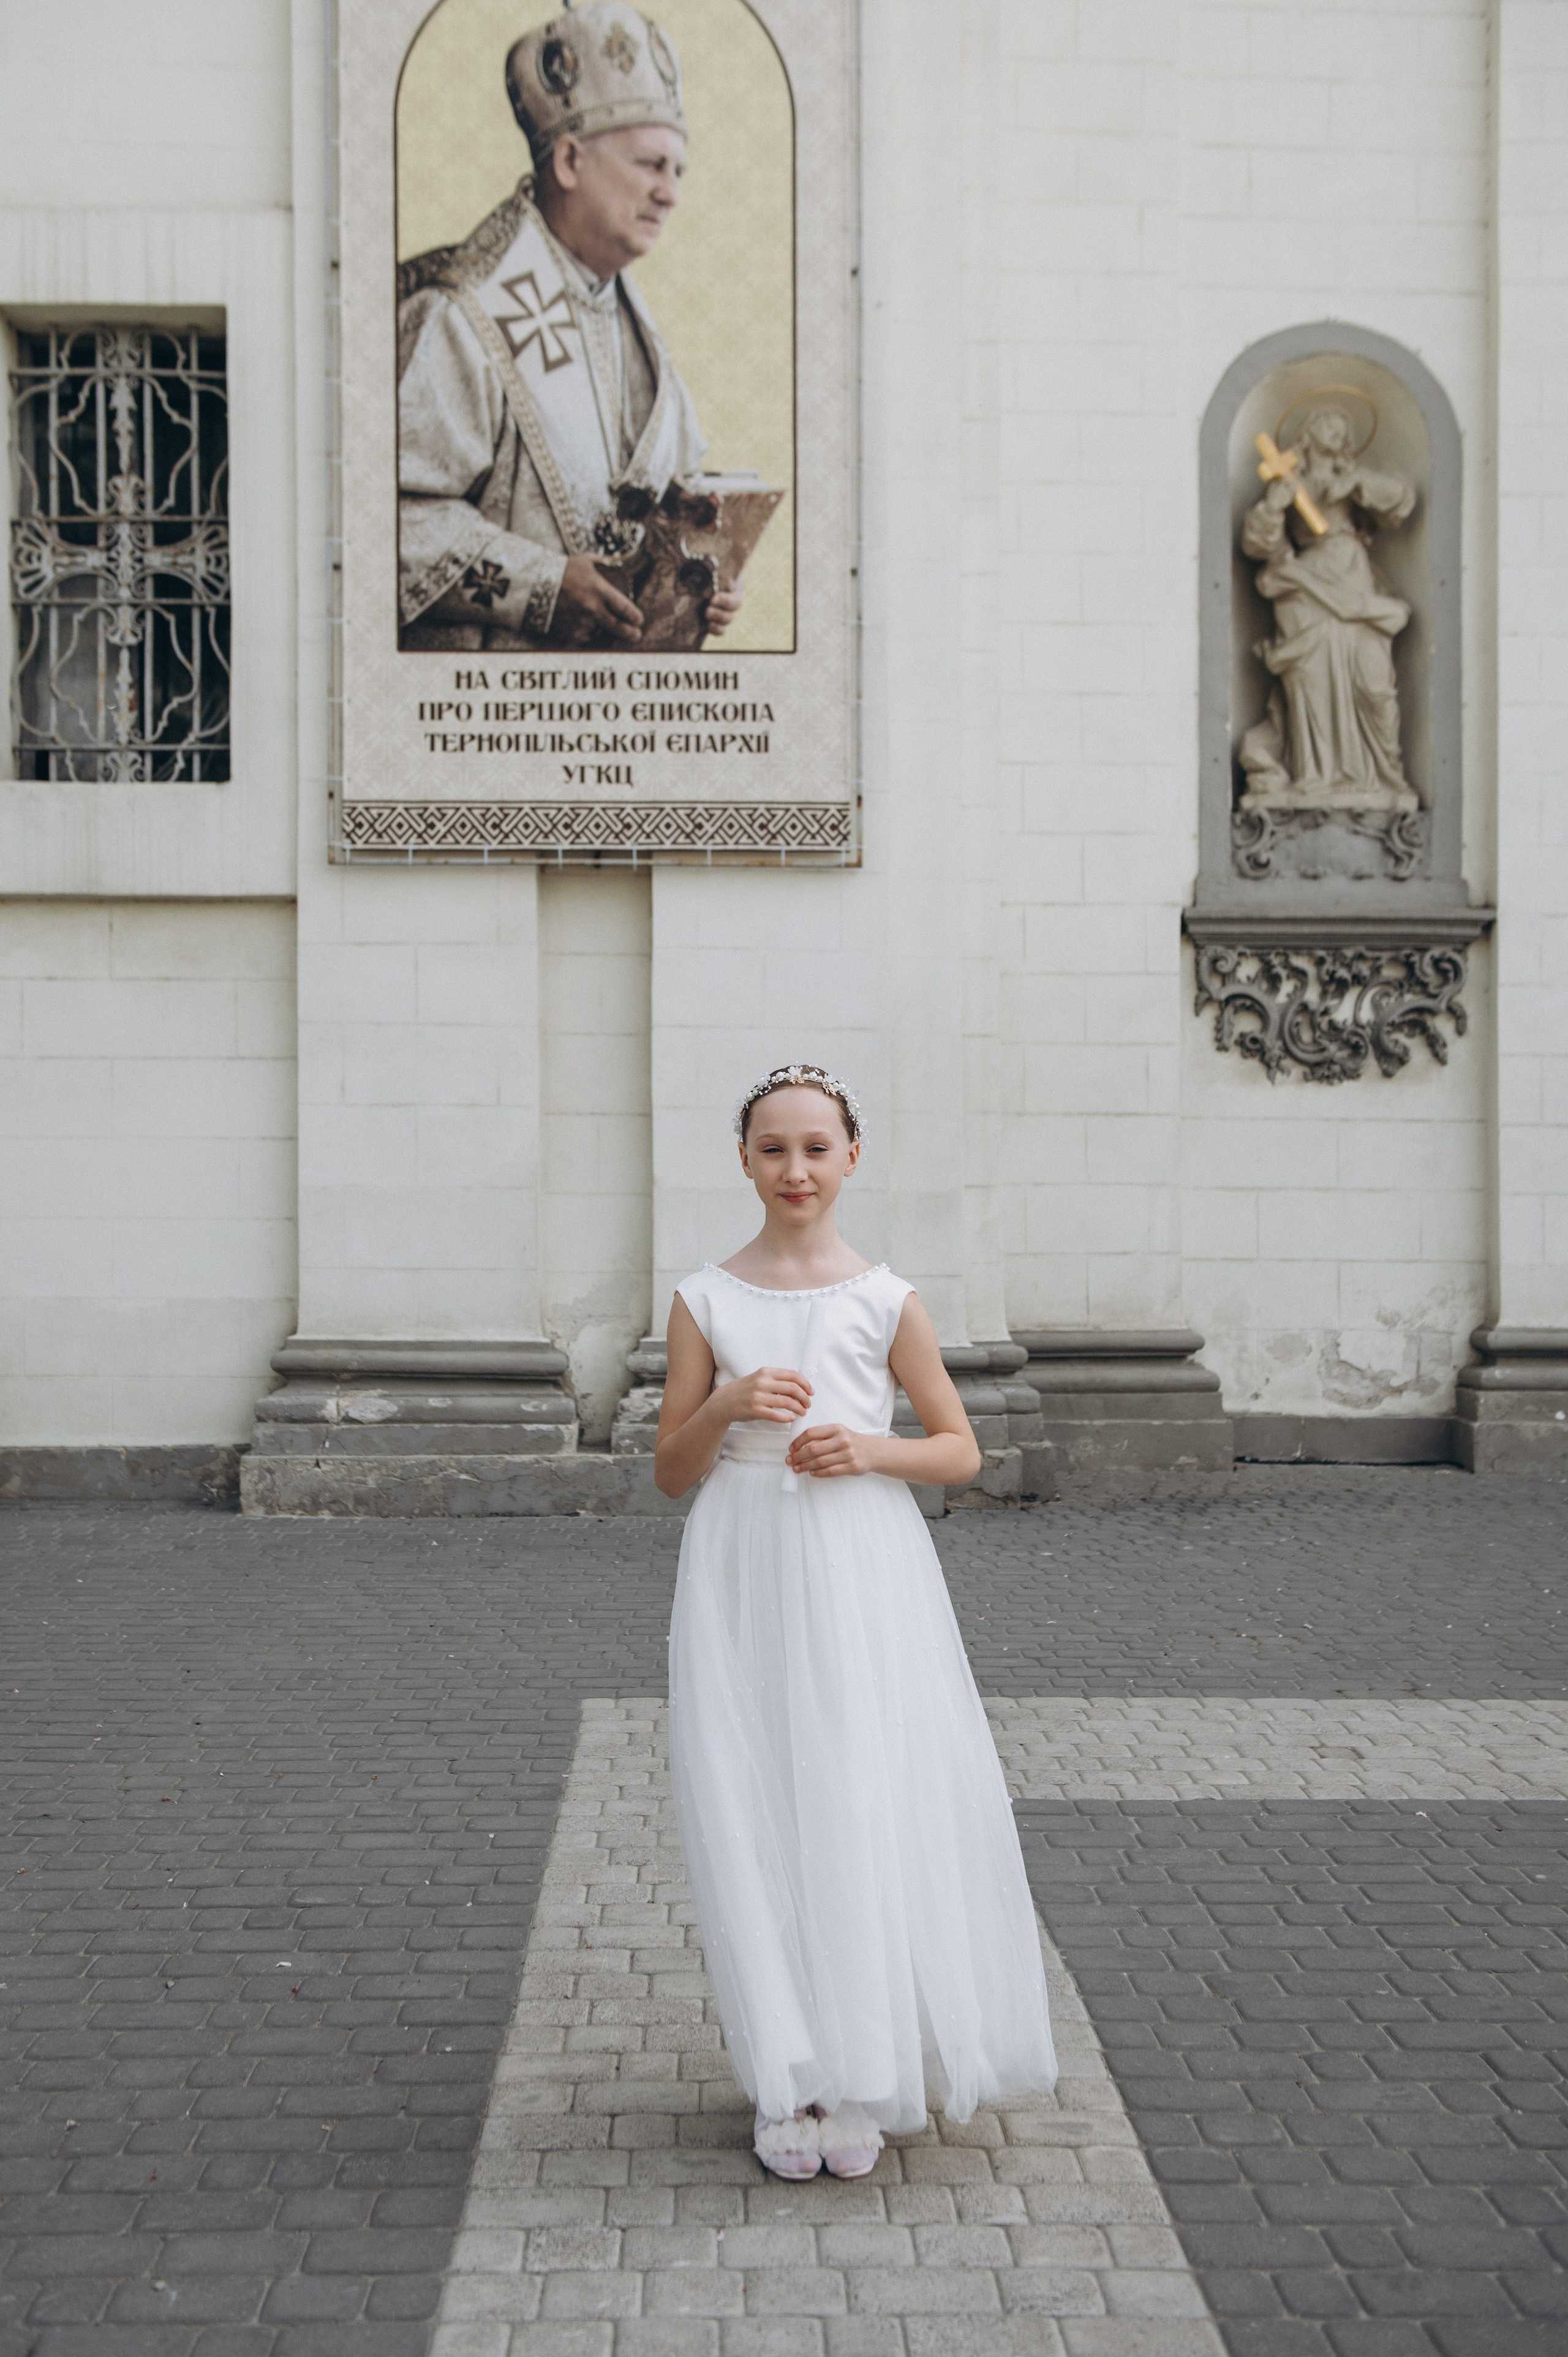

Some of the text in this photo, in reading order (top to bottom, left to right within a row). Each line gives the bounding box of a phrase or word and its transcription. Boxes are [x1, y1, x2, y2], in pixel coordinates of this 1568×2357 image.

[454, 666, 739, 691] НА СВІТЛИЙ СПОМИН
[418, 701, 775, 723] ПРО ПЕРШОГО ЄПИСКОПА
[424, 730, 770, 754] ТЕРНОПІЛЬСЬКОЇ ЄПАРХІЇ
[562, 764, 634, 788] УГКЦ
